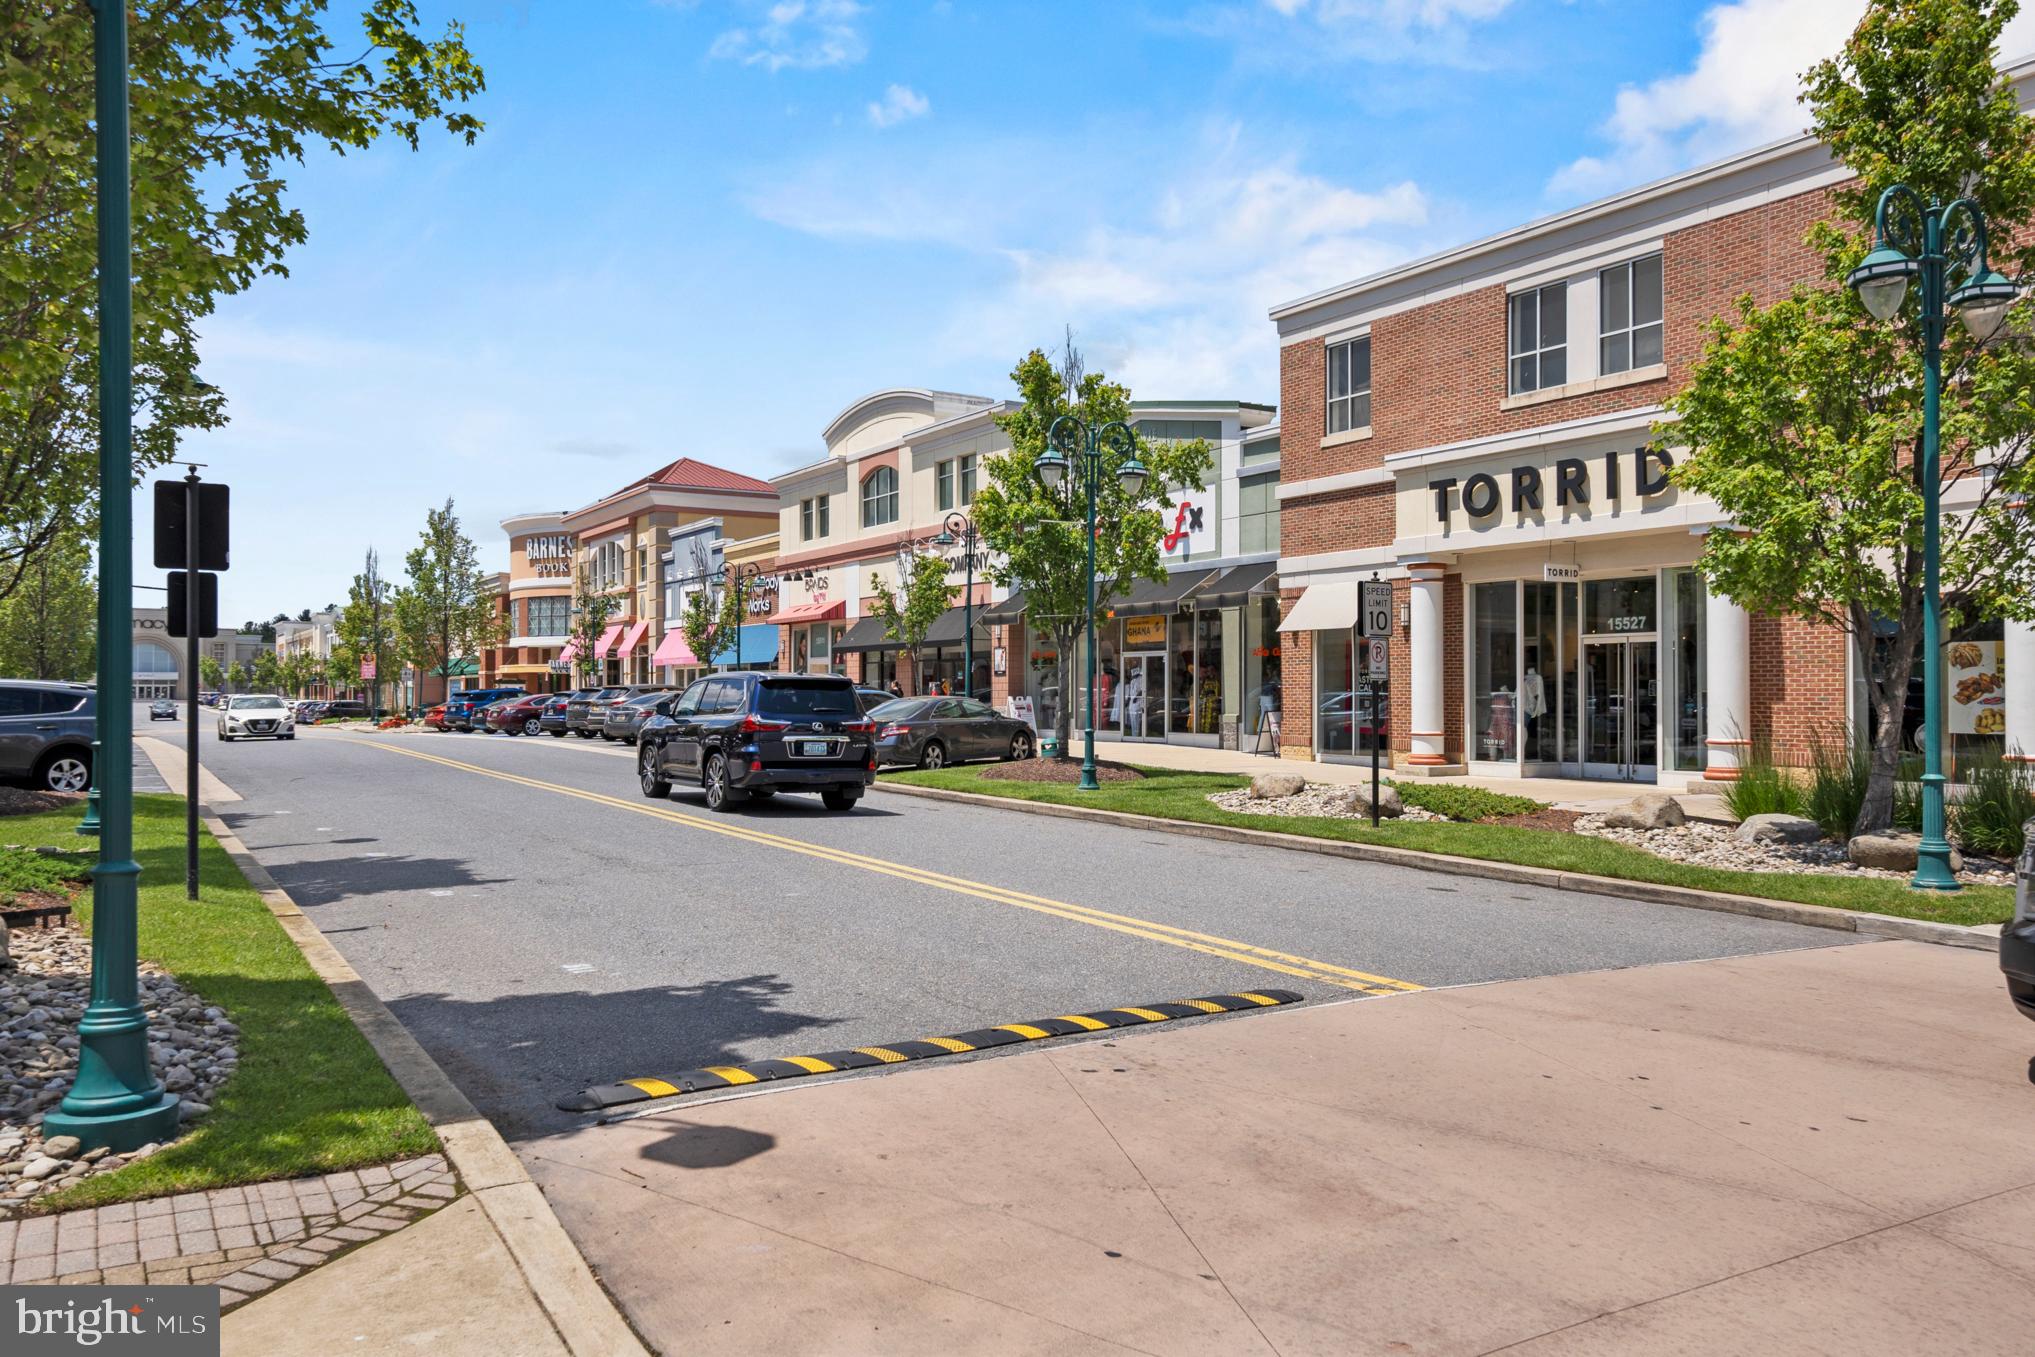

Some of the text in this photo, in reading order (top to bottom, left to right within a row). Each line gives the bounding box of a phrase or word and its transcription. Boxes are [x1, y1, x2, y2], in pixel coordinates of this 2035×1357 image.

[1429, 447, 1675, 522] TORRID
[526, 536, 573, 560] BARNES
[536, 562, 569, 573] BOOK
[944, 551, 990, 574] COMANY
[1547, 568, 1579, 578] TORRID
[1366, 587, 1391, 596] SPEED
[1368, 599, 1388, 607] LIMIT
[1369, 611, 1388, 630] 10
[1608, 616, 1647, 631] 15527
